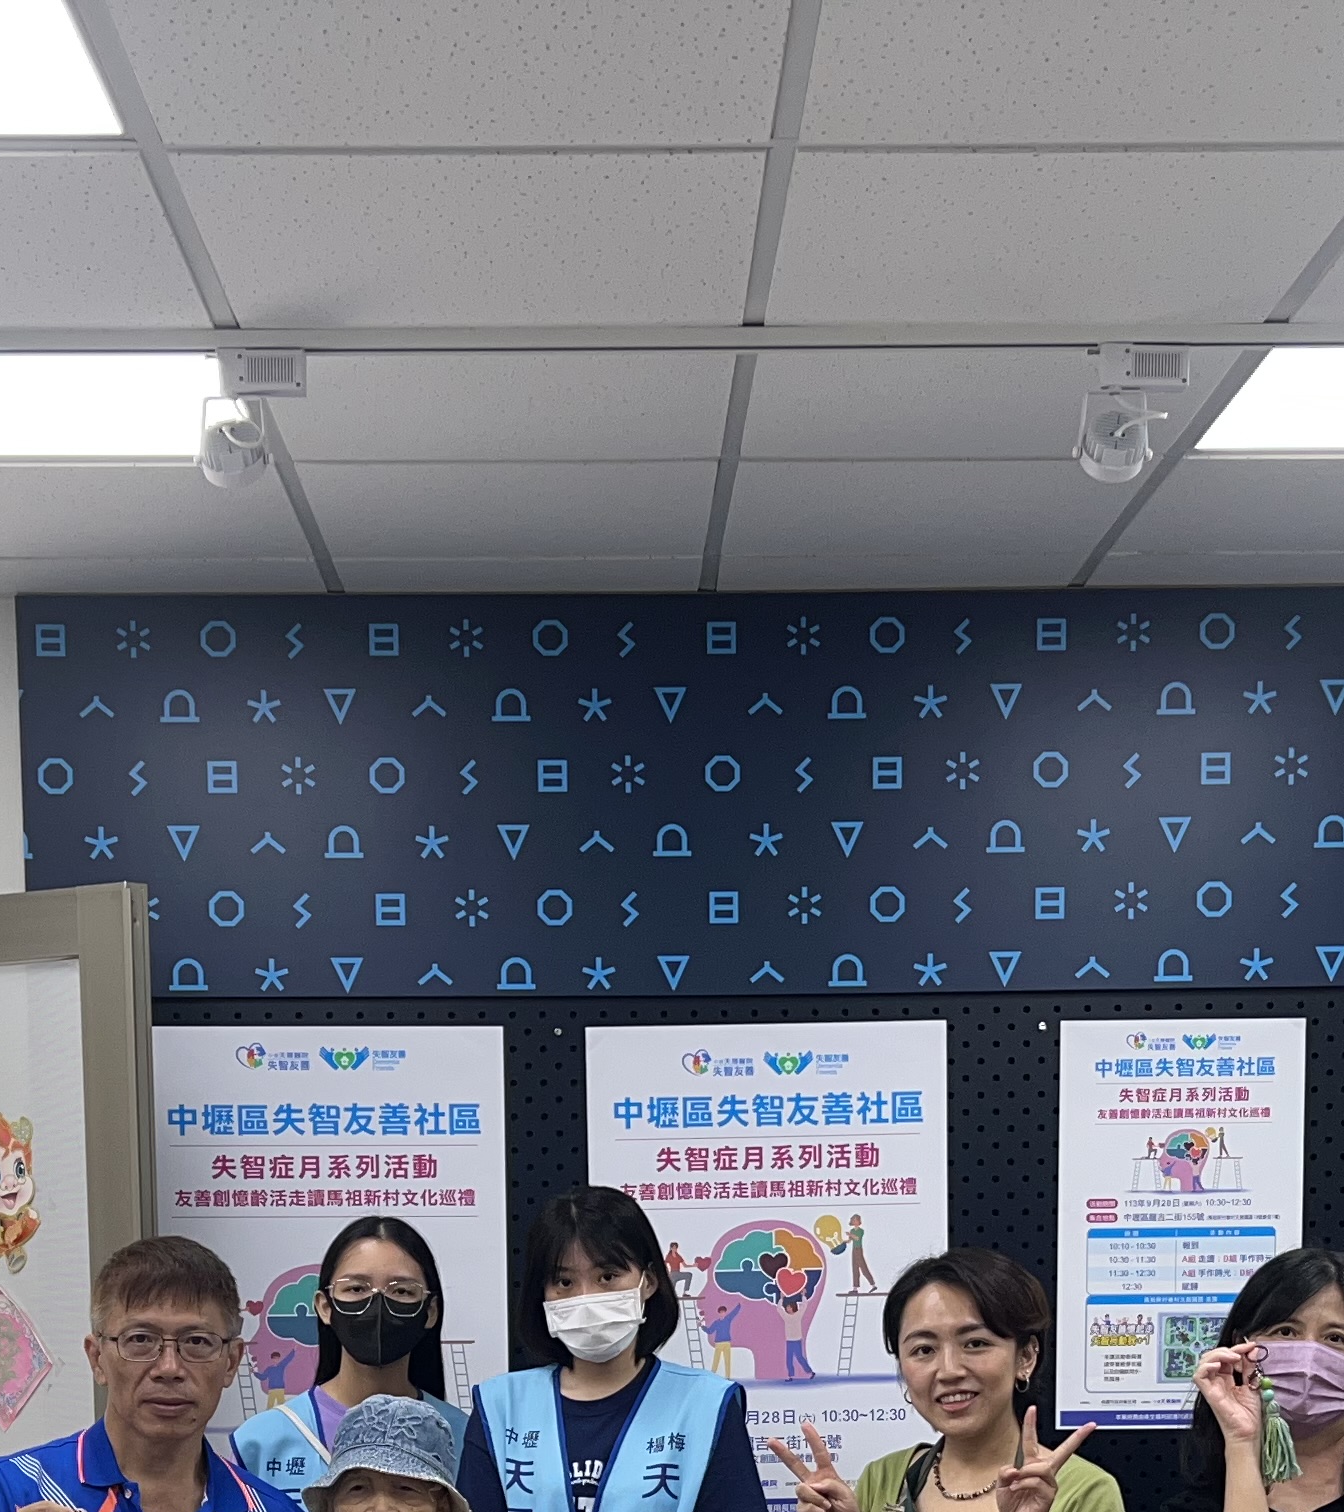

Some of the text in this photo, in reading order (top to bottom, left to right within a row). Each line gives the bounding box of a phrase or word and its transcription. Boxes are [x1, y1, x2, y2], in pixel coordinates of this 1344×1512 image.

[1094, 1056, 1276, 1079] 中壢區失智友善社區
[1119, 1086, 1250, 1103] 失智症月系列活動
[167, 1102, 482, 1137] 中壢區失智友善社區
[613, 1090, 924, 1130] 中壢區失智友善社區
[211, 1154, 439, 1180] 失智症月系列活動
[656, 1142, 880, 1173] 失智症月系列活動
[174, 1187, 476, 1208] 友善創憶齡活走讀馬祖新村文化巡禮
[821, 1408, 906, 1423] 10:30~12:30
[646, 1431, 686, 1454] 楊梅
[266, 1456, 306, 1477] 中壢
[569, 1459, 604, 1480] LID
